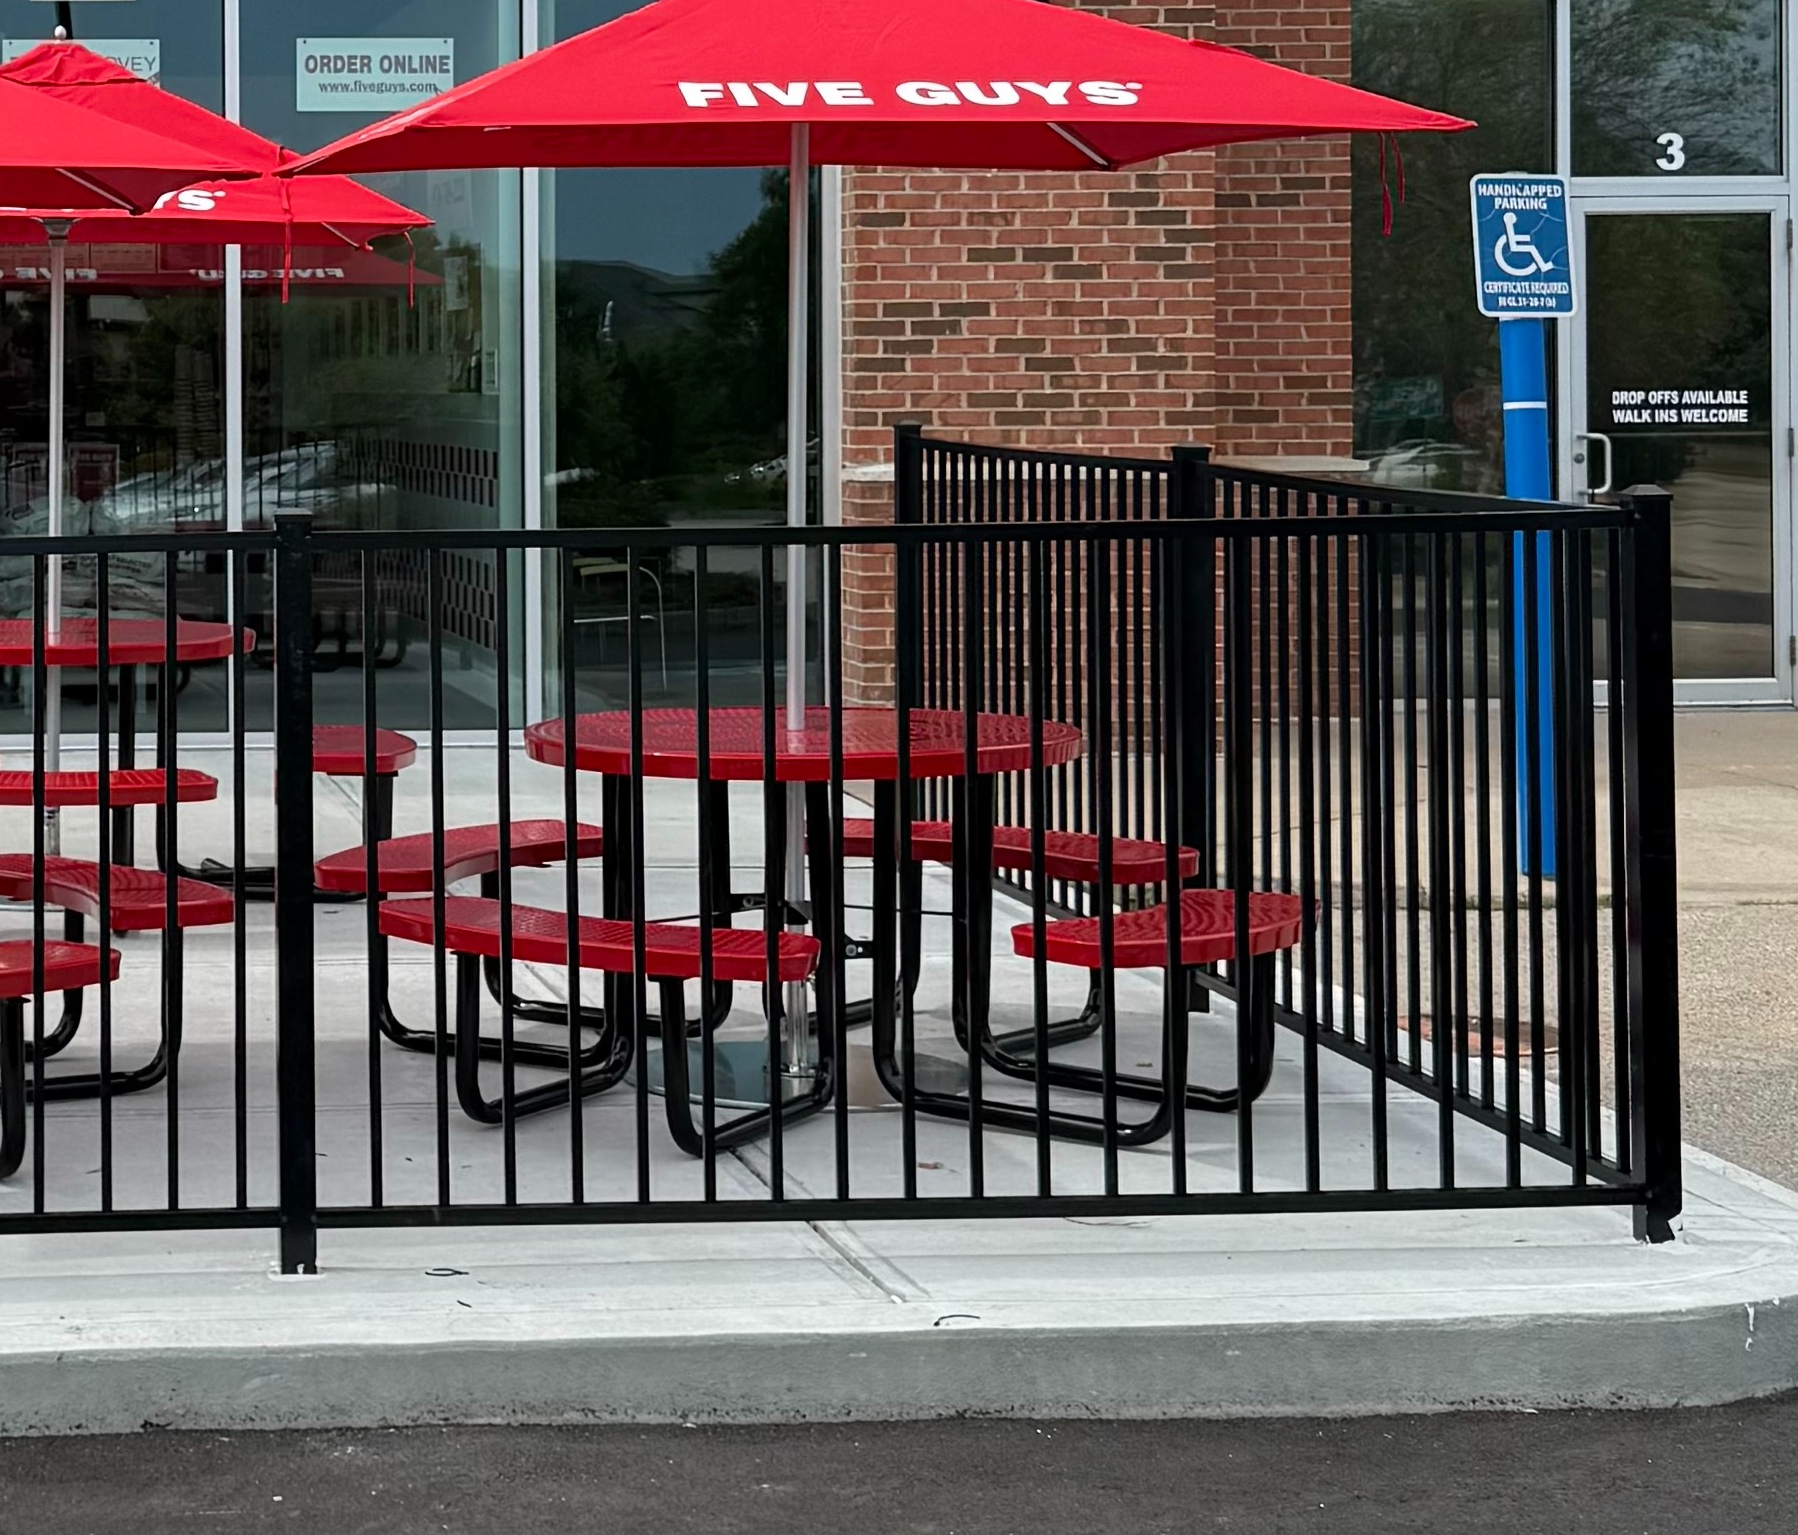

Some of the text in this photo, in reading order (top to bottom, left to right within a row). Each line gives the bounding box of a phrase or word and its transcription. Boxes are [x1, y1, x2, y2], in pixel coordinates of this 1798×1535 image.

[304, 55, 451, 74] ORDER ONLINE
[677, 81, 1139, 107] FIVE GUYS
[1656, 133, 1686, 171] 3
[1478, 184, 1562, 198] HANDICAPPED
[1494, 198, 1548, 210] PARKING
[1612, 390, 1748, 404] DROP OFFS AVAILABLE
[1612, 409, 1748, 423] WALK INS WELCOME
